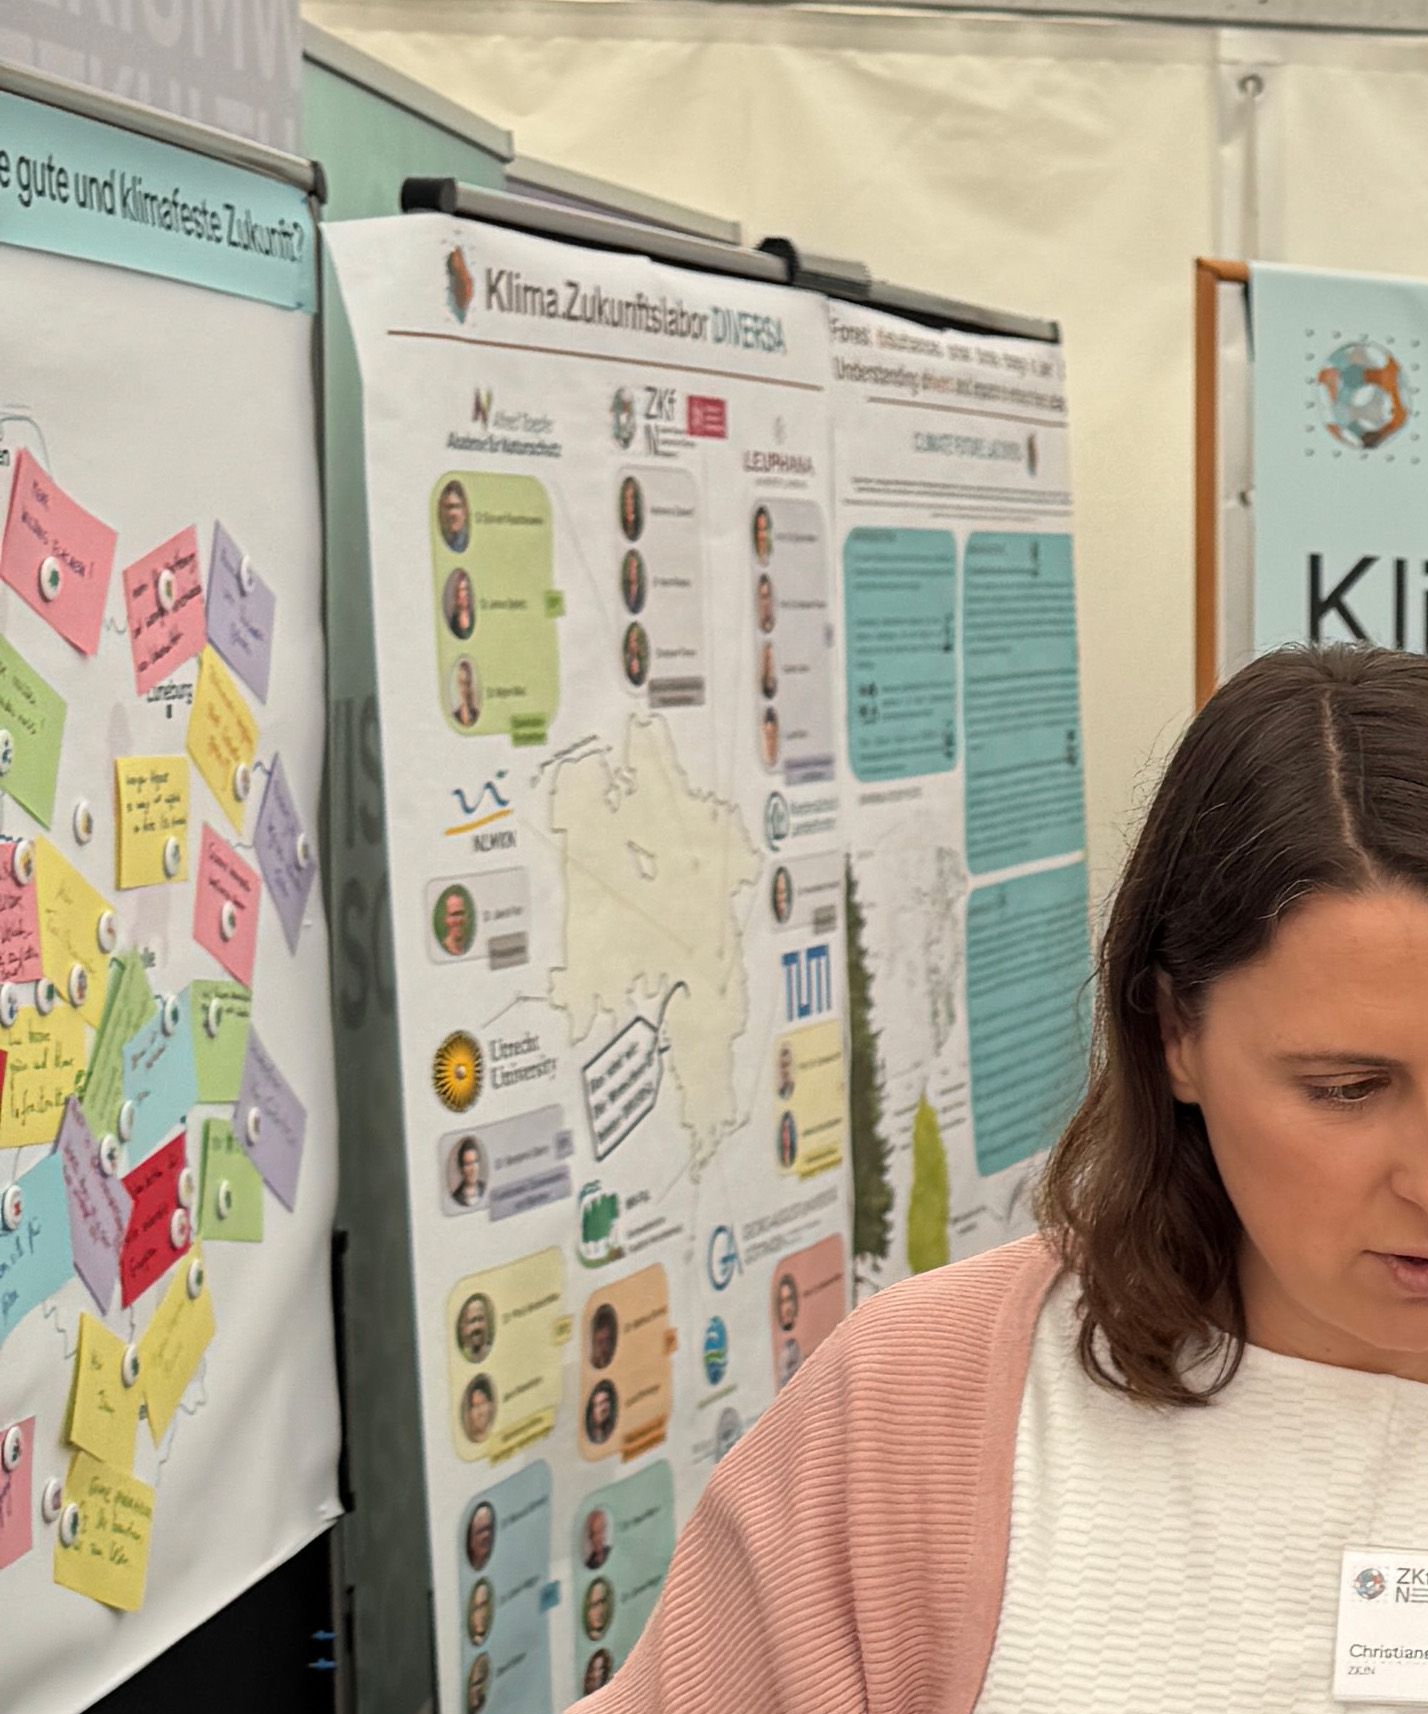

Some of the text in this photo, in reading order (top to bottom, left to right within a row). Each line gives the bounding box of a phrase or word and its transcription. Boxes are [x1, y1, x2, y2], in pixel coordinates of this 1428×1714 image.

[16, 153, 70, 208] gute
[74, 168, 116, 215] und
[119, 171, 223, 244] klimafeste
[222, 203, 305, 263] Zukunft?
[485, 268, 788, 355] Klima.Zukunftslabor DIVERSA
[490, 1030, 540, 1061] Utrecht
[1395, 1586, 1410, 1603] N
